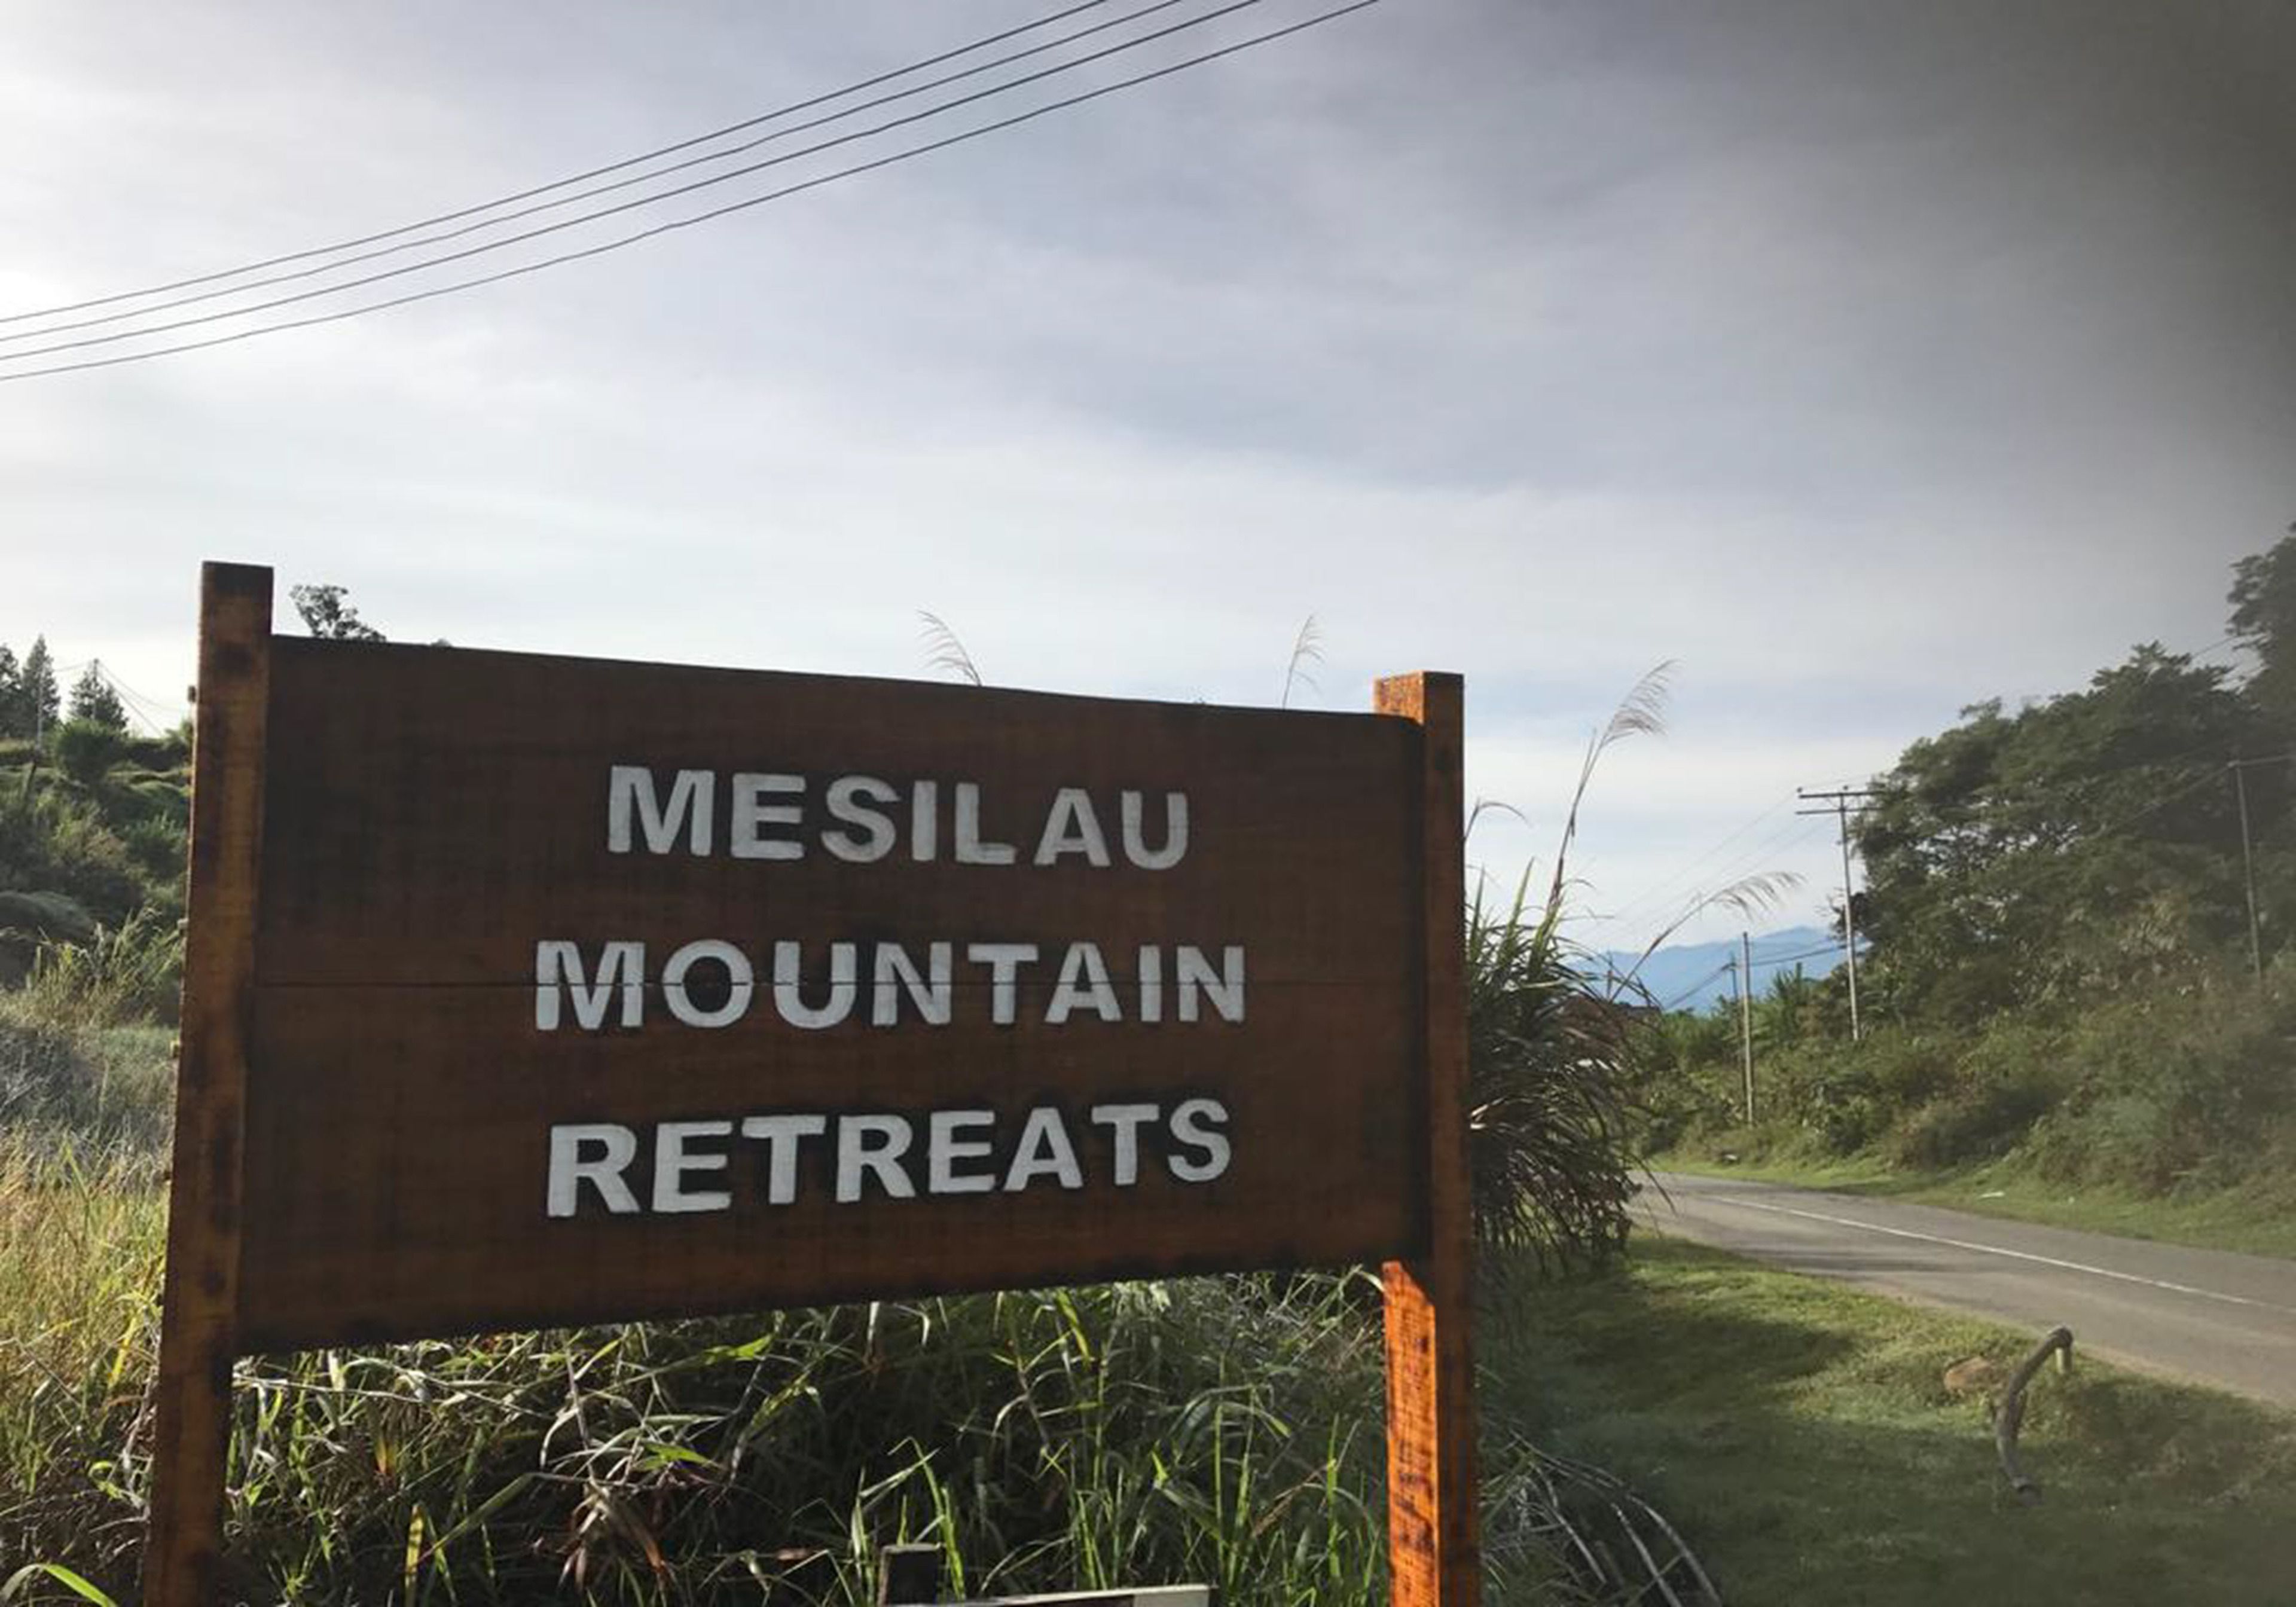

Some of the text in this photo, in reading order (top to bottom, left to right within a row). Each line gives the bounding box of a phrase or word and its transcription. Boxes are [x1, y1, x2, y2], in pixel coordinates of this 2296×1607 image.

[607, 765, 1189, 870] MESILAU
[535, 939, 1245, 1031] MOUNTAIN
[546, 1099, 1232, 1218] RETREATS
